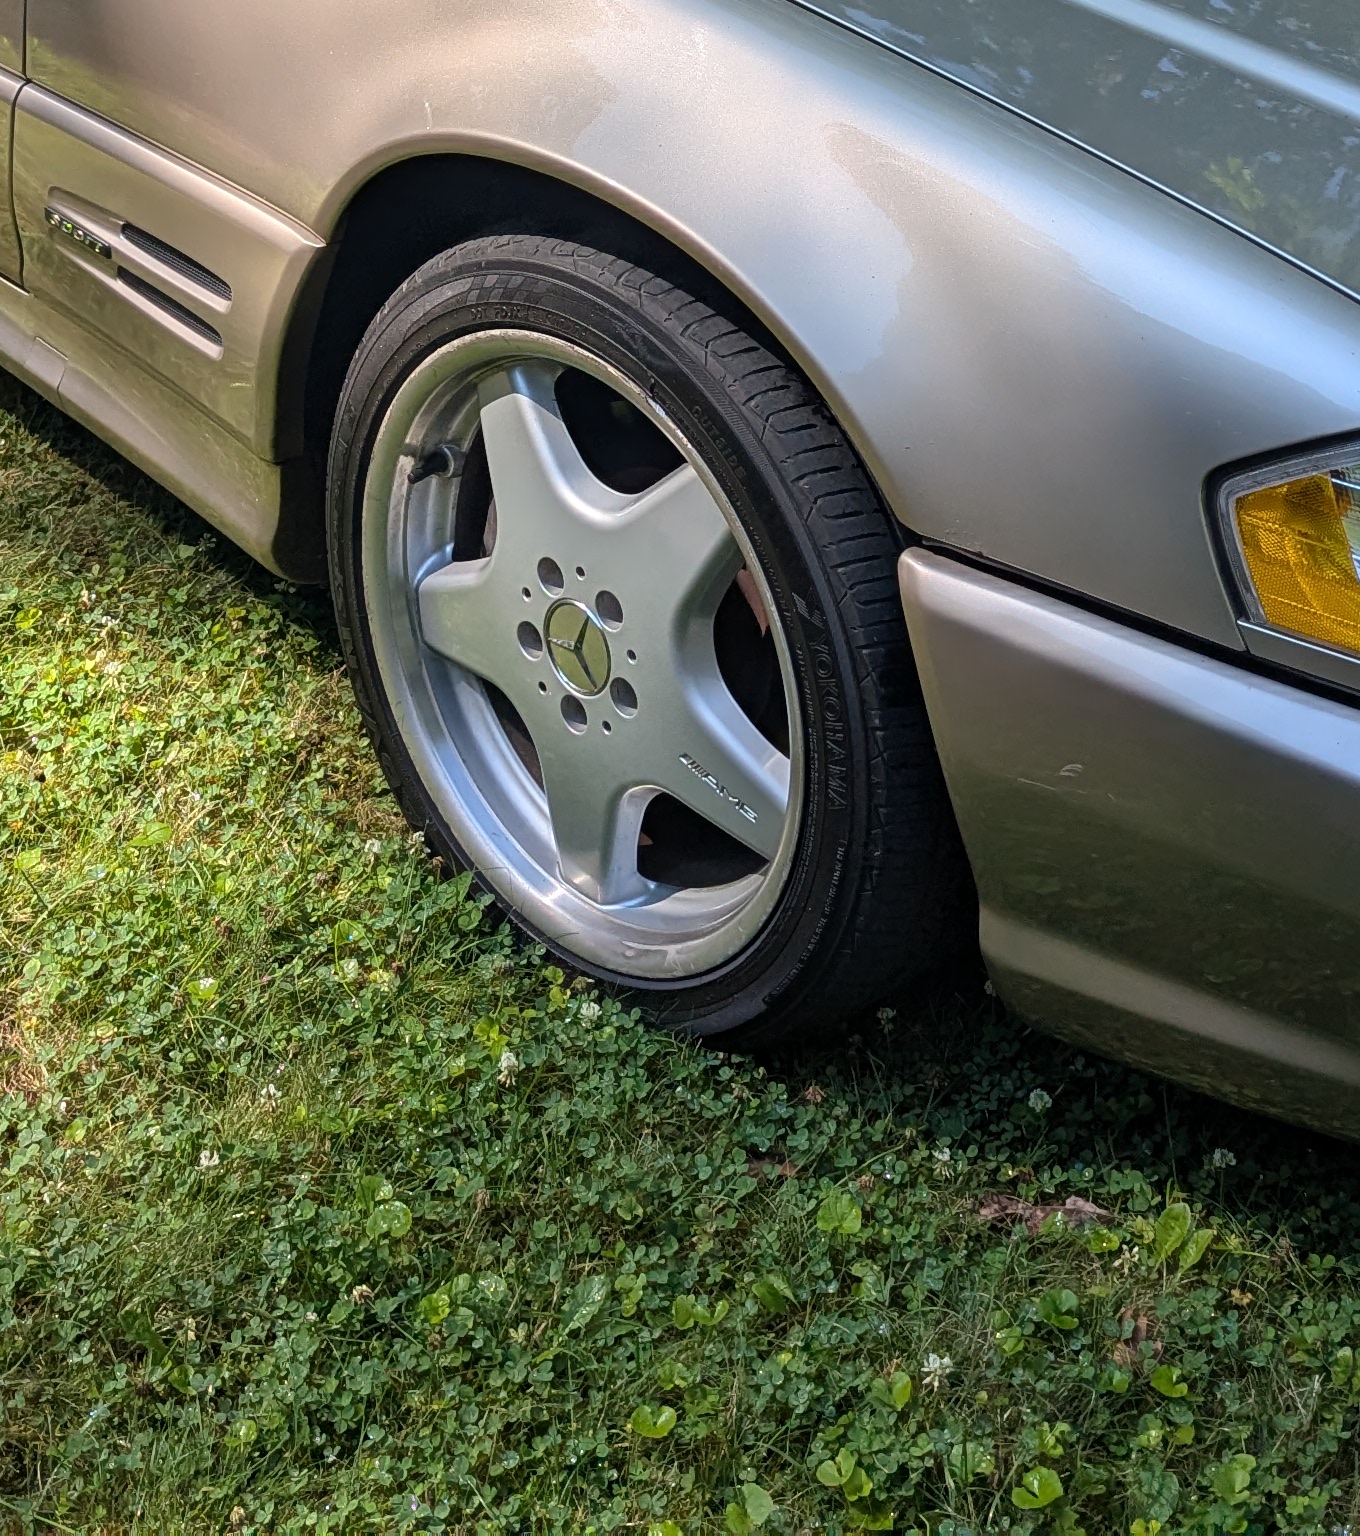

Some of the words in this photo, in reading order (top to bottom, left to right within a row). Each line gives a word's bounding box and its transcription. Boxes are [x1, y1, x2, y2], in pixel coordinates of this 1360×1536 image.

[690, 404, 747, 478] OUTSIDE
[809, 632, 848, 811] YOKOHAMA
[698, 767, 759, 824] AMG
